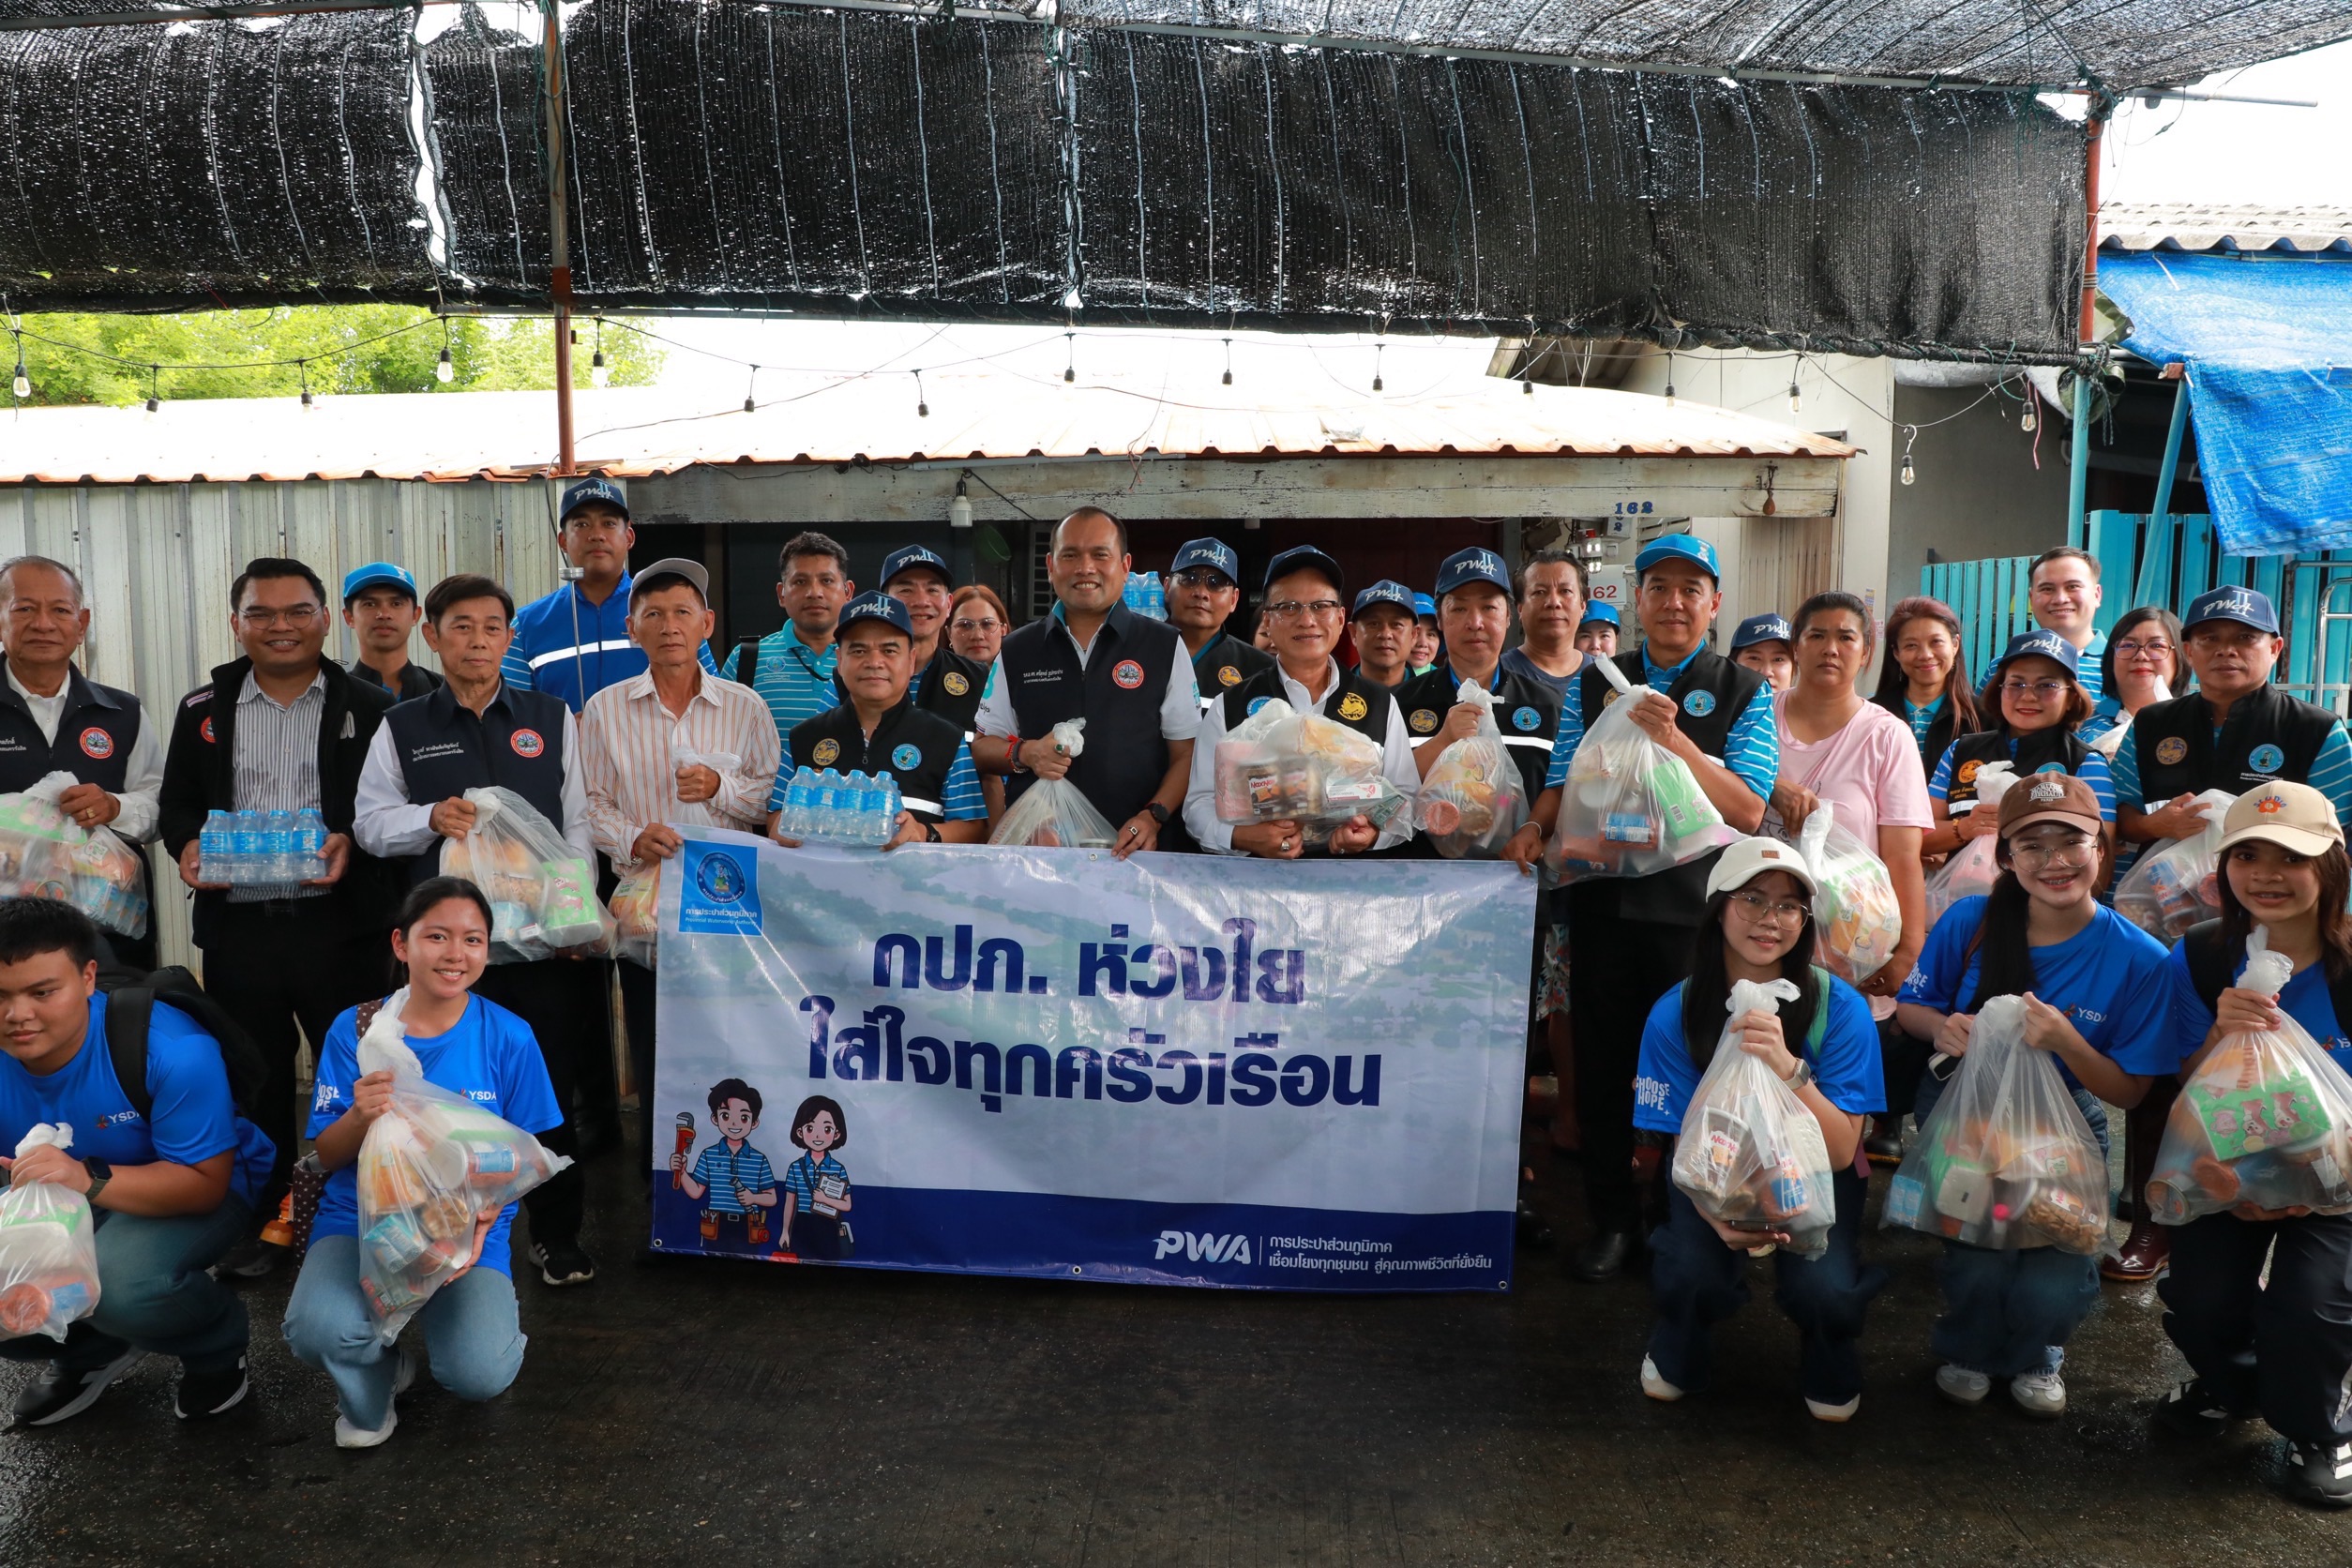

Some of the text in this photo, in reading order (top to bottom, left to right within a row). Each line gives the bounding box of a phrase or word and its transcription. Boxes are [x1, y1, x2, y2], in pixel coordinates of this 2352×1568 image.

[1614, 501, 1653, 515] 162
[873, 917, 1305, 1004] กปภ. ห่วงใย
[799, 995, 1382, 1113] ใส่ใจทุกครัวเรือน
[1637, 1090, 1665, 1111] HOPE
[108, 1110, 140, 1123] YSD
[1152, 1230, 1251, 1264] PWA
[1270, 1236, 1393, 1255] การประปาส่วนภูมิภาค
[1269, 1250, 1493, 1274] เชื่อมโยงทุกชุมชน สู่คุณภาพชีวิตที่ยั่งยืน
